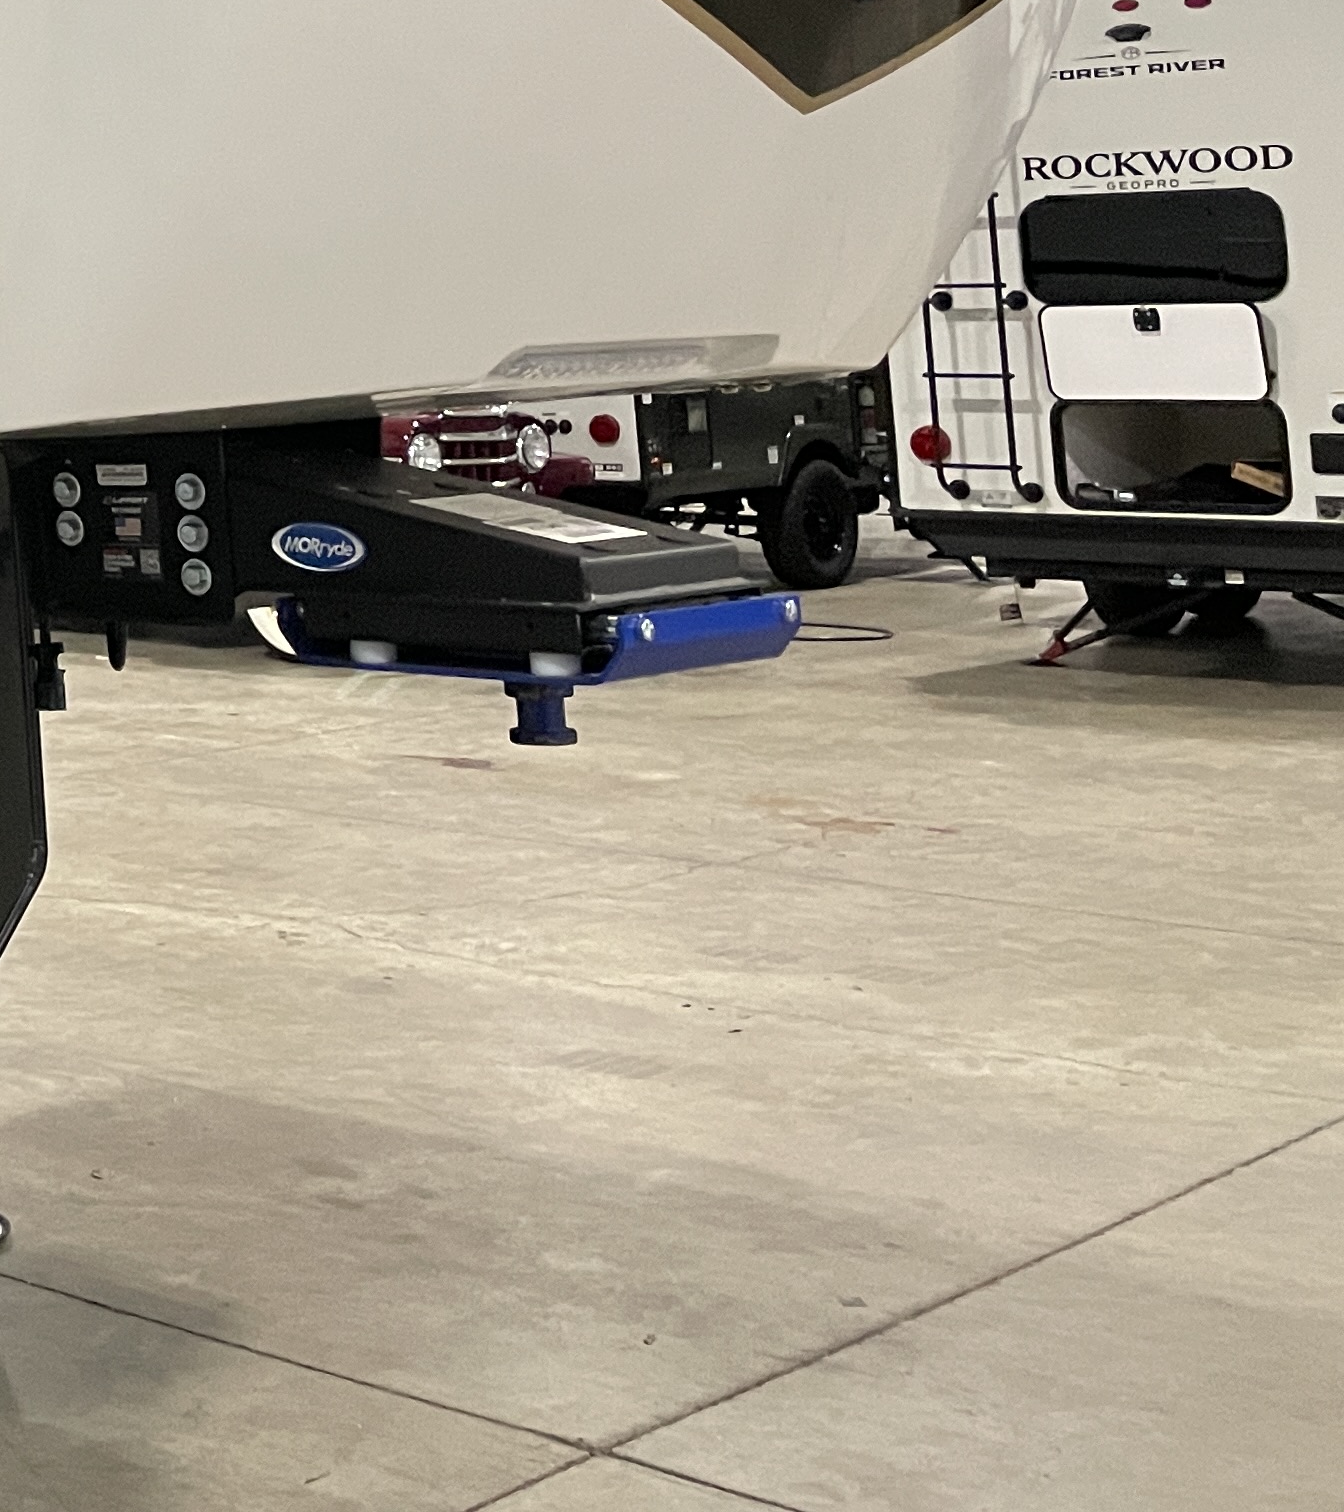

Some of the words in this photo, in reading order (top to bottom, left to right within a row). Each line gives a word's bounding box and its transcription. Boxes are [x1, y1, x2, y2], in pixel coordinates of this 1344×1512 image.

[1147, 58, 1225, 74] RIVER
[1021, 143, 1294, 181] ROCKWOOD
[1106, 178, 1180, 191] GEOPRO
